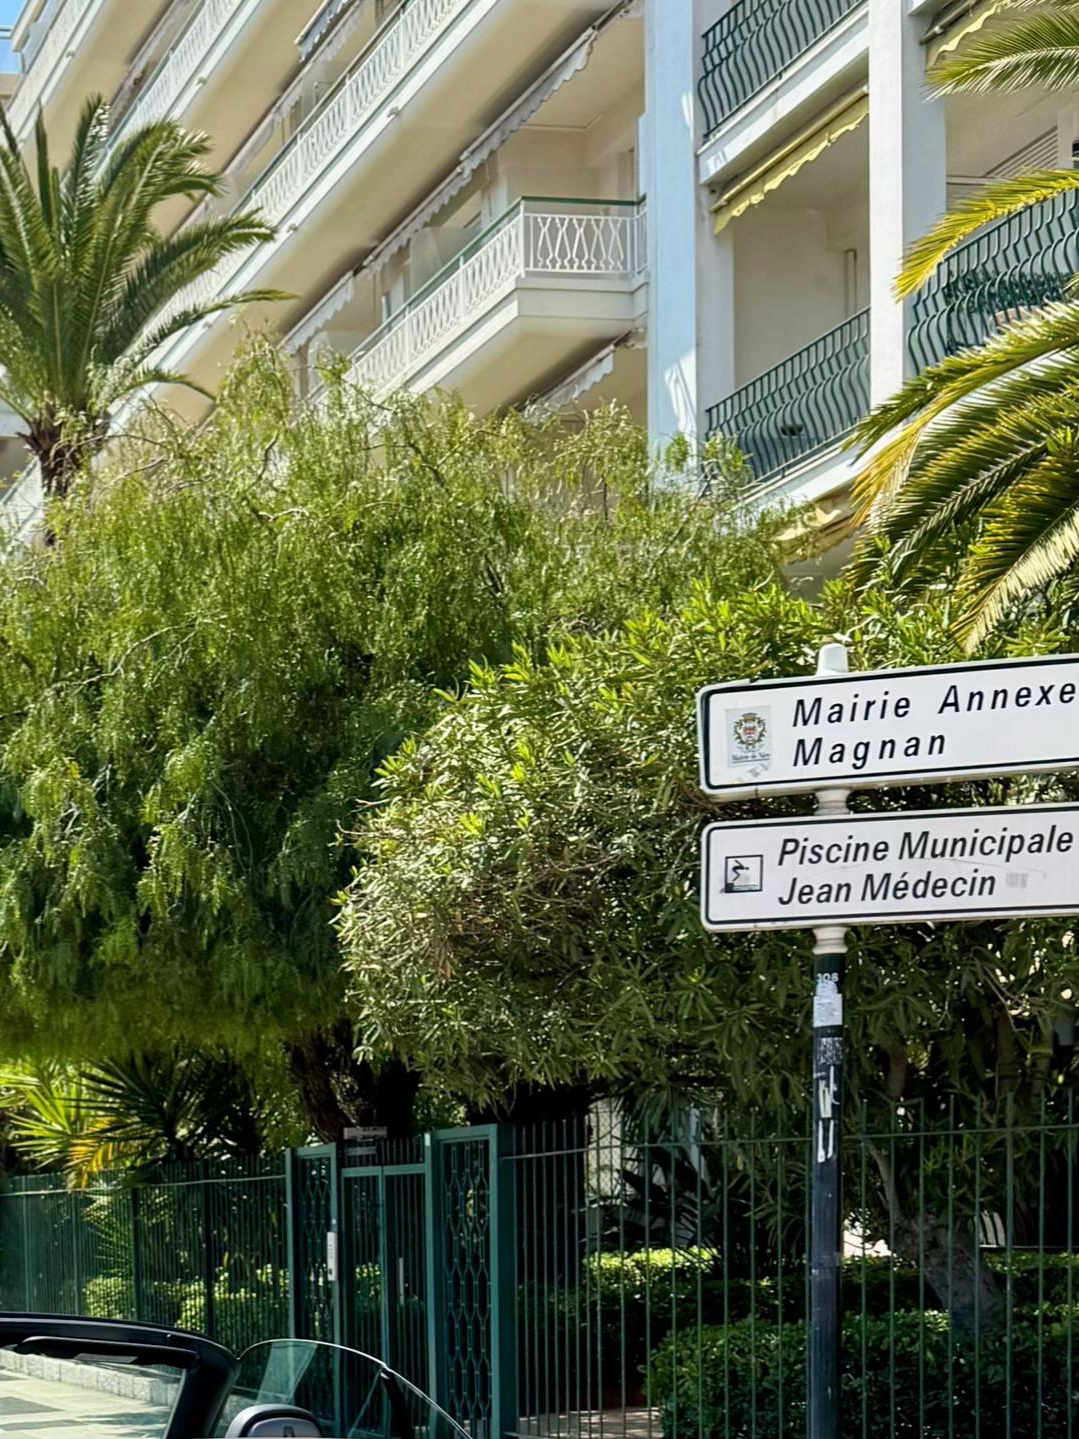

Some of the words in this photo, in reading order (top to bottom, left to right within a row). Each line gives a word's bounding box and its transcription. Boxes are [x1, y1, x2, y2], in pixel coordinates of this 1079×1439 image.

[792, 690, 911, 728] Mairie
[937, 682, 1077, 714] Annexe
[792, 733, 946, 770] Magnan
[777, 834, 889, 866] Piscine
[898, 824, 1074, 863] Municipale
[778, 877, 852, 906] Jean
[861, 868, 996, 902] Médecin
